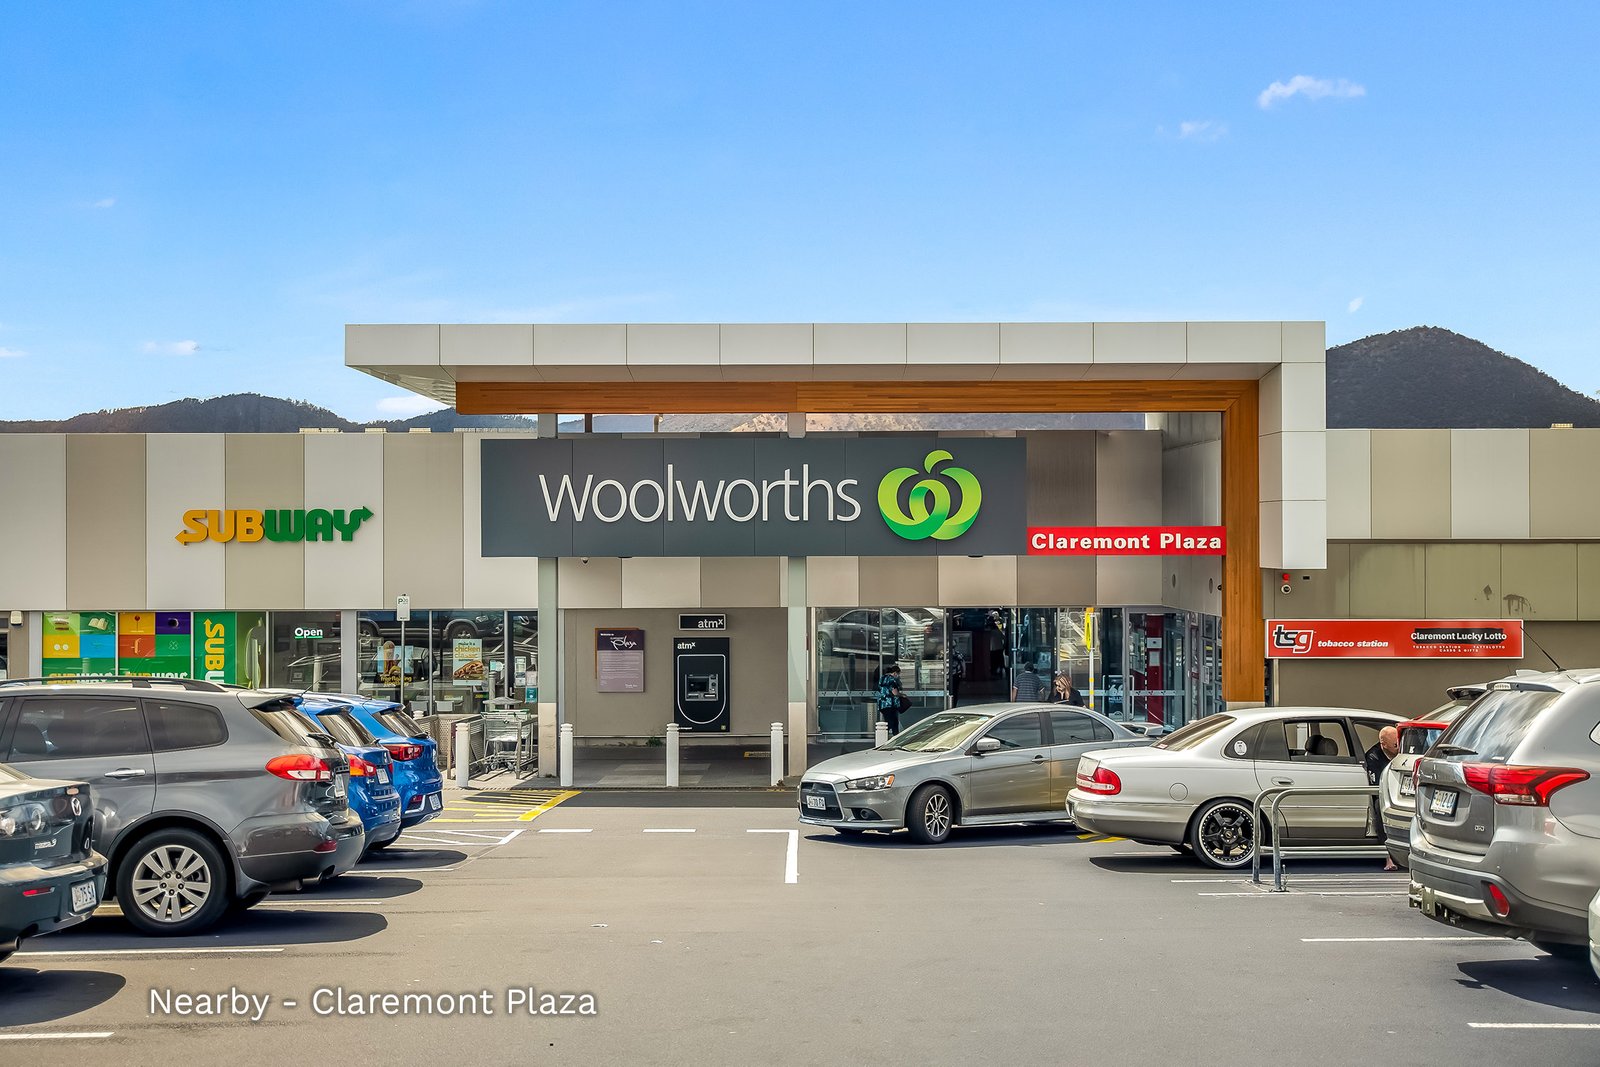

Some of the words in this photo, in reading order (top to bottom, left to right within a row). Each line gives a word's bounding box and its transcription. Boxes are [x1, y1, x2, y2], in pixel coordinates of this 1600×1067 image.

[538, 463, 862, 523] Woolworths
[175, 506, 374, 545] SUBWAY
[1031, 533, 1150, 549] Claremont
[1160, 533, 1222, 549] Plaza
[294, 627, 323, 639] Open
[1272, 624, 1314, 654] tsg
[1410, 632, 1456, 640] Claremont
[1457, 632, 1483, 642] Lucky
[1484, 632, 1508, 640] Lotto
[1317, 639, 1354, 647] tobacco
[1357, 639, 1389, 647] station
